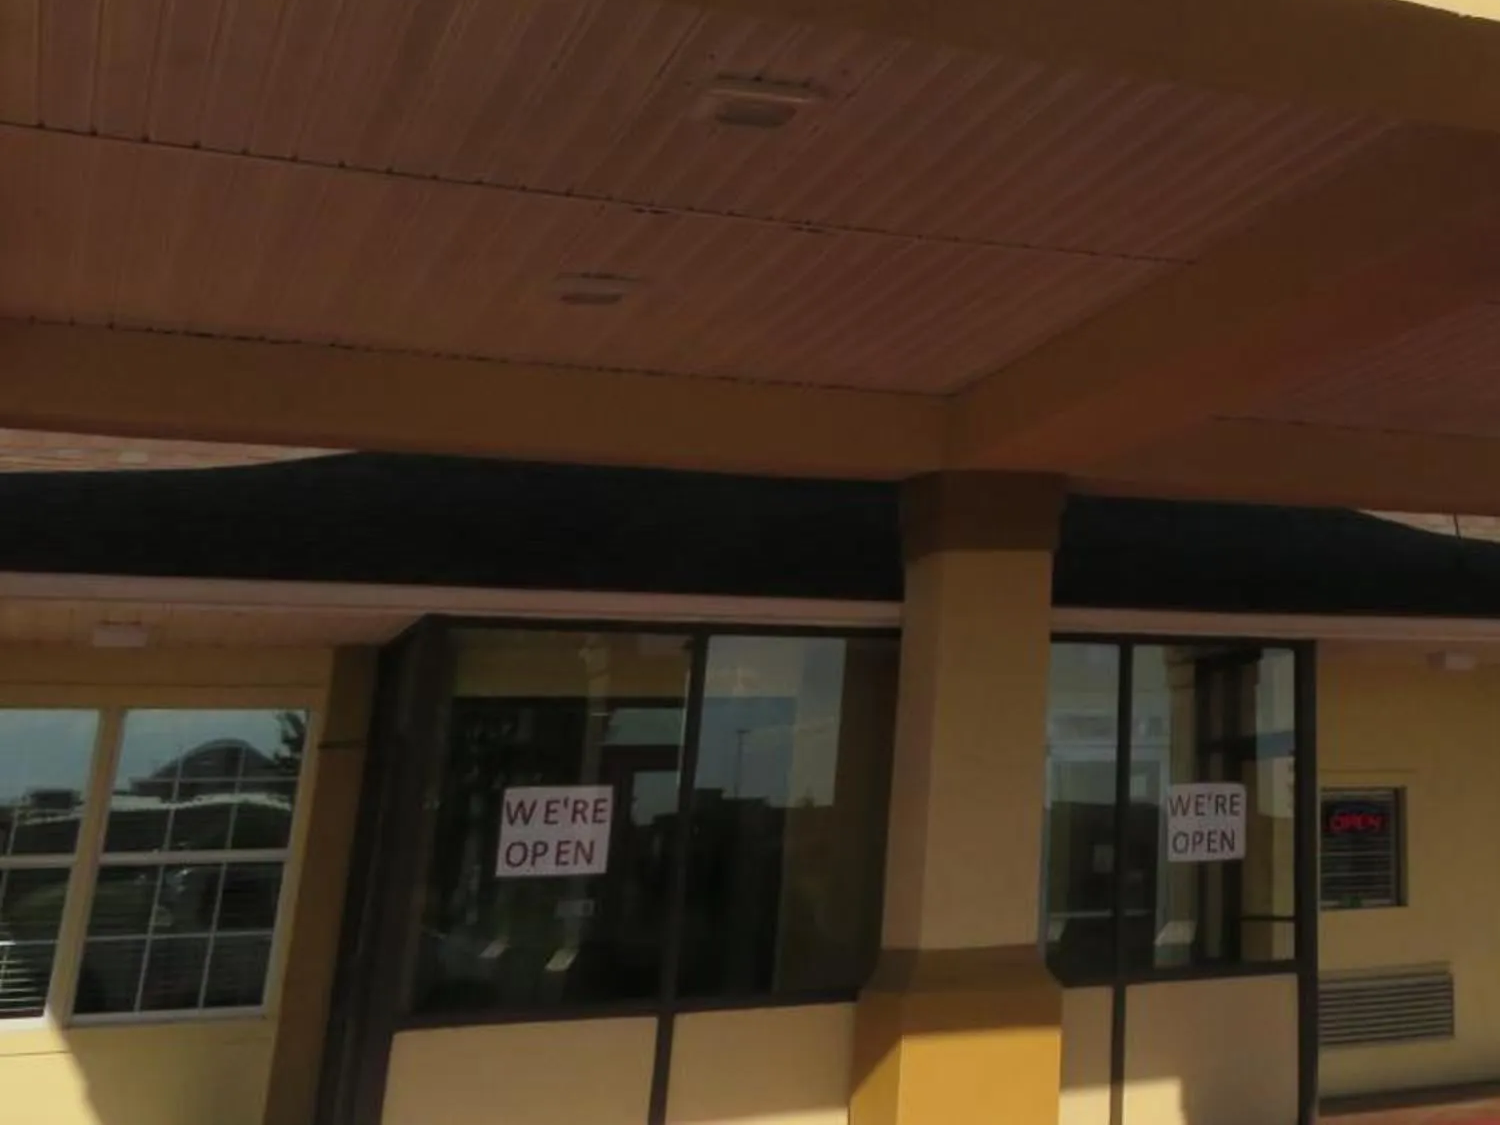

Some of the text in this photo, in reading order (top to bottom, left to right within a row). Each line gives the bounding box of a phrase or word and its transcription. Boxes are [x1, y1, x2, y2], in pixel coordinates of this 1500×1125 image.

[505, 796, 608, 826] WE'RE
[1168, 793, 1241, 817] WE'RE
[505, 840, 595, 868] OPEN
[1172, 829, 1235, 854] OPEN
